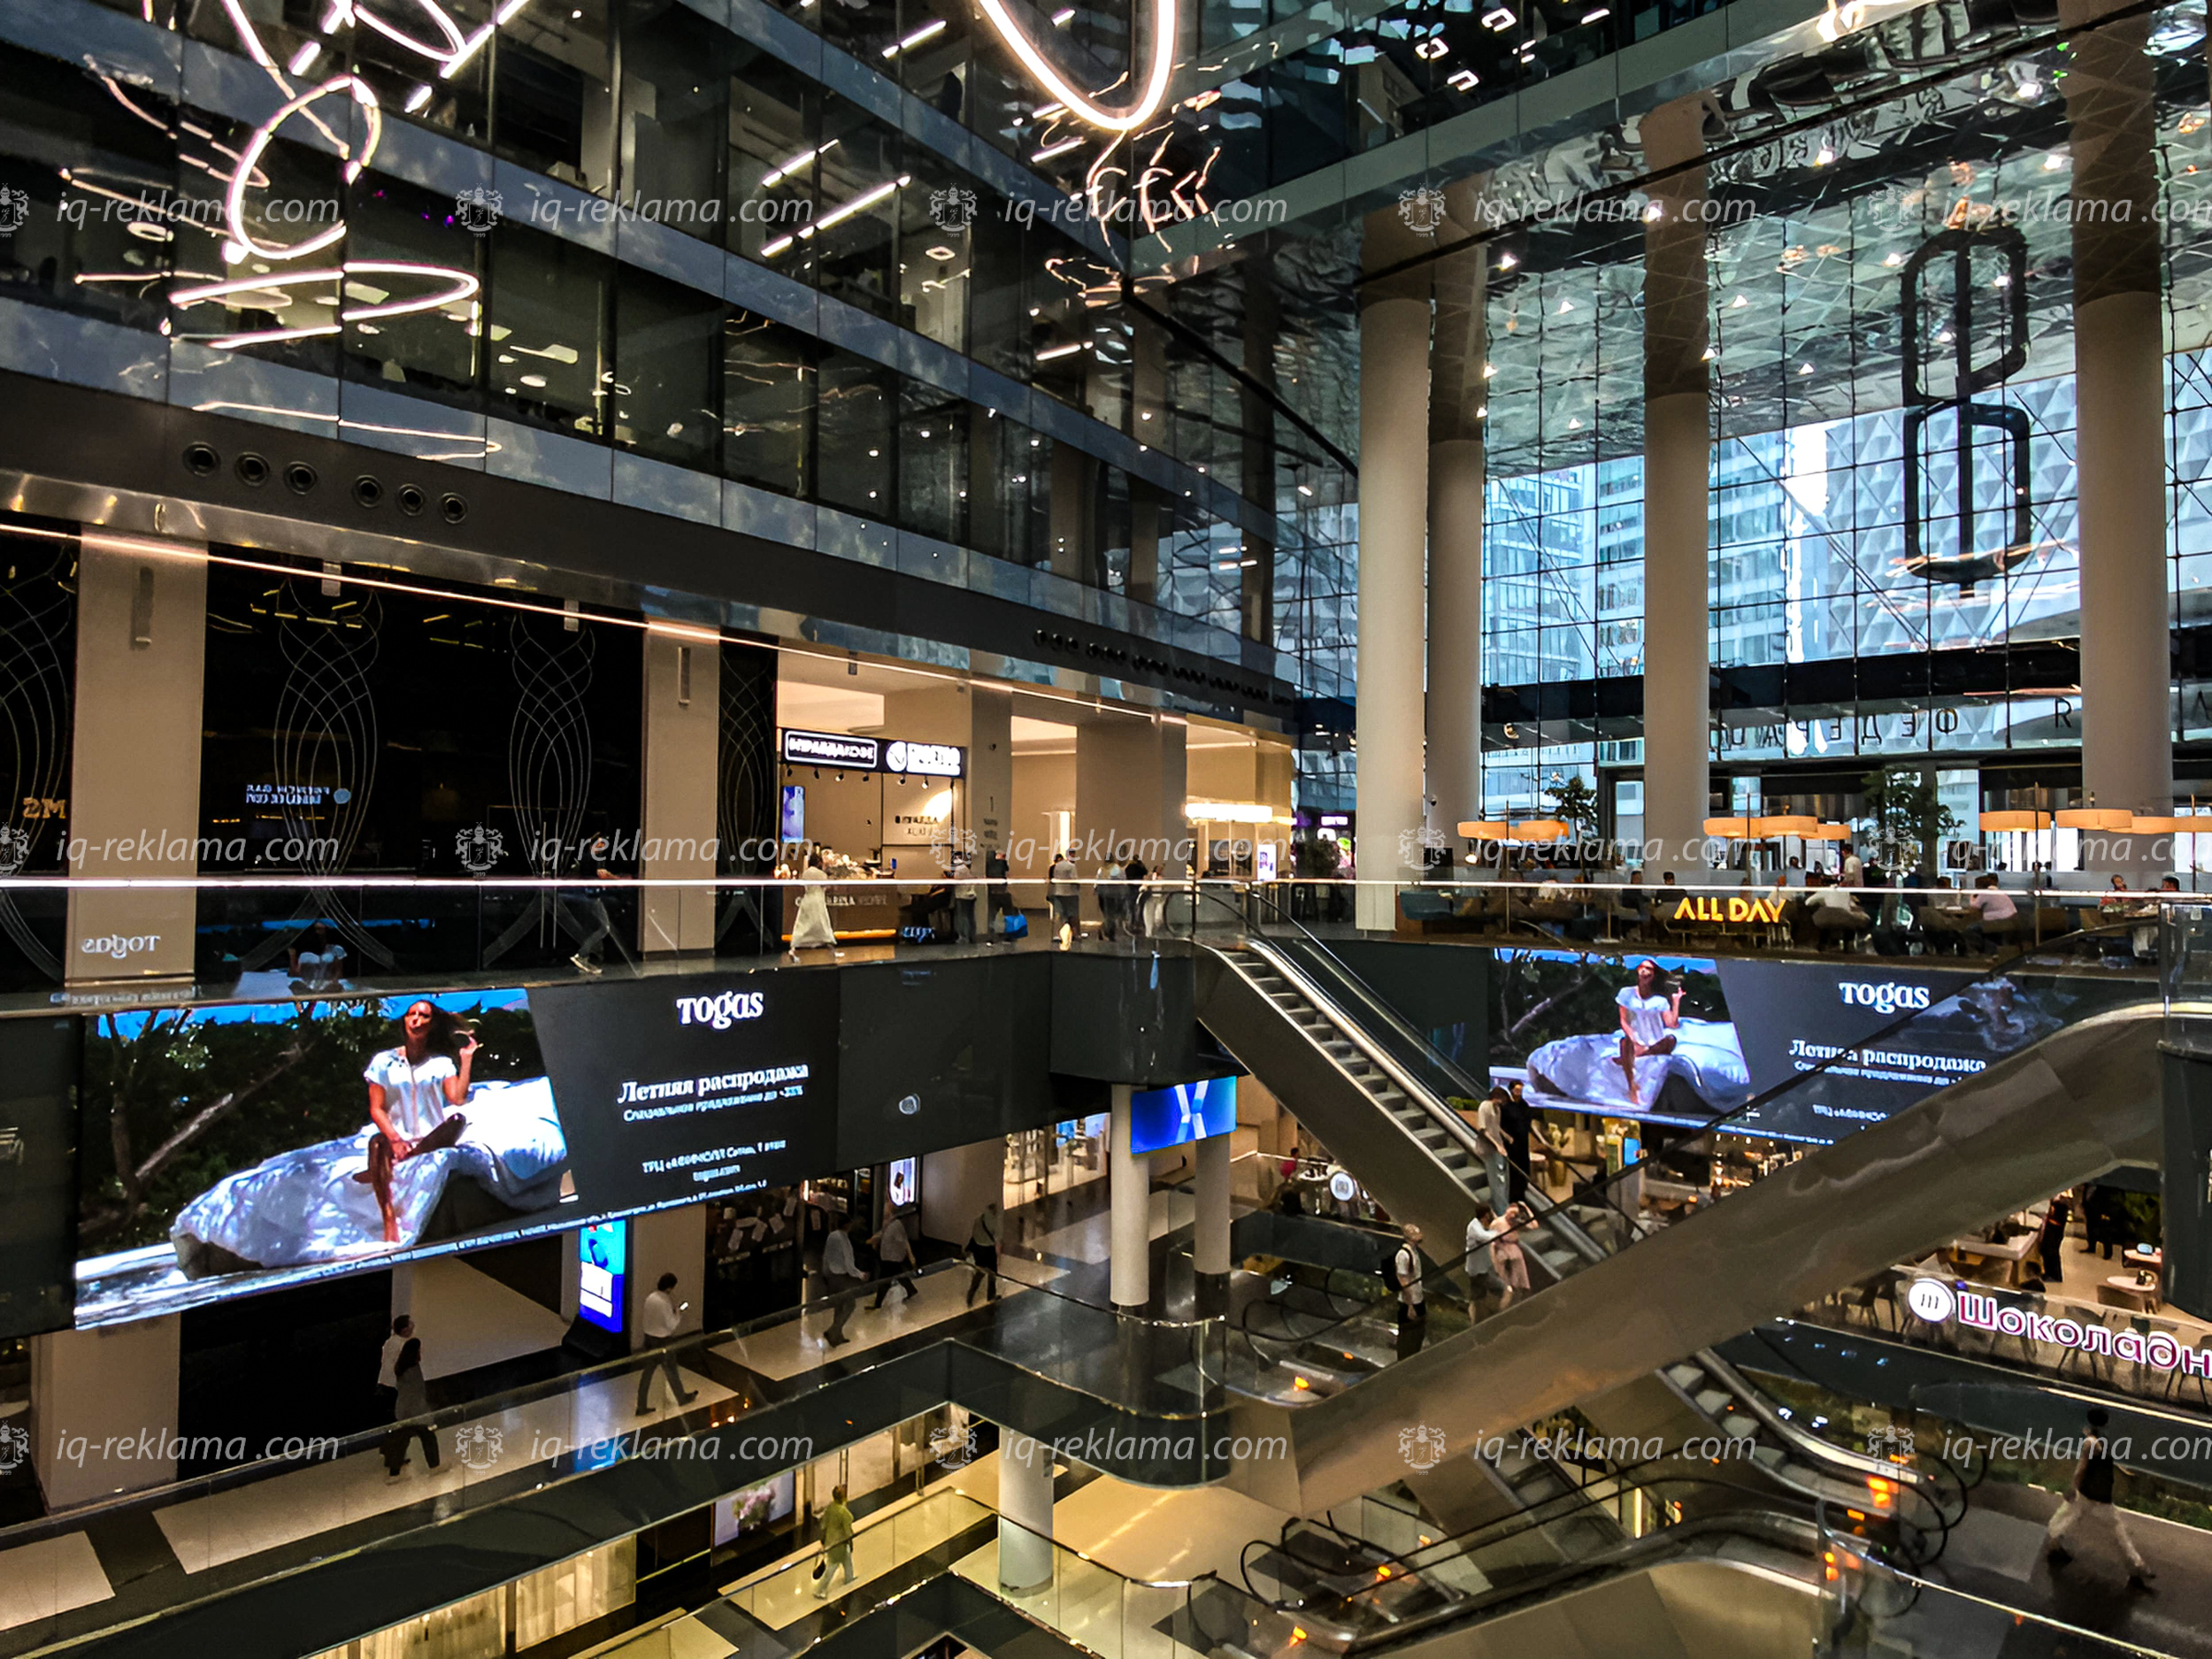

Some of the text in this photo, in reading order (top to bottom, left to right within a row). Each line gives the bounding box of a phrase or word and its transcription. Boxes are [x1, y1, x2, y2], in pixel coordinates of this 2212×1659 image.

[1673, 896, 1786, 923] ALL DAY
[676, 990, 764, 1029] Togas
[1838, 981, 1931, 1014] Togas
[698, 1064, 809, 1092] распродажа
[1957, 1291, 2212, 1379] Шоколадн
